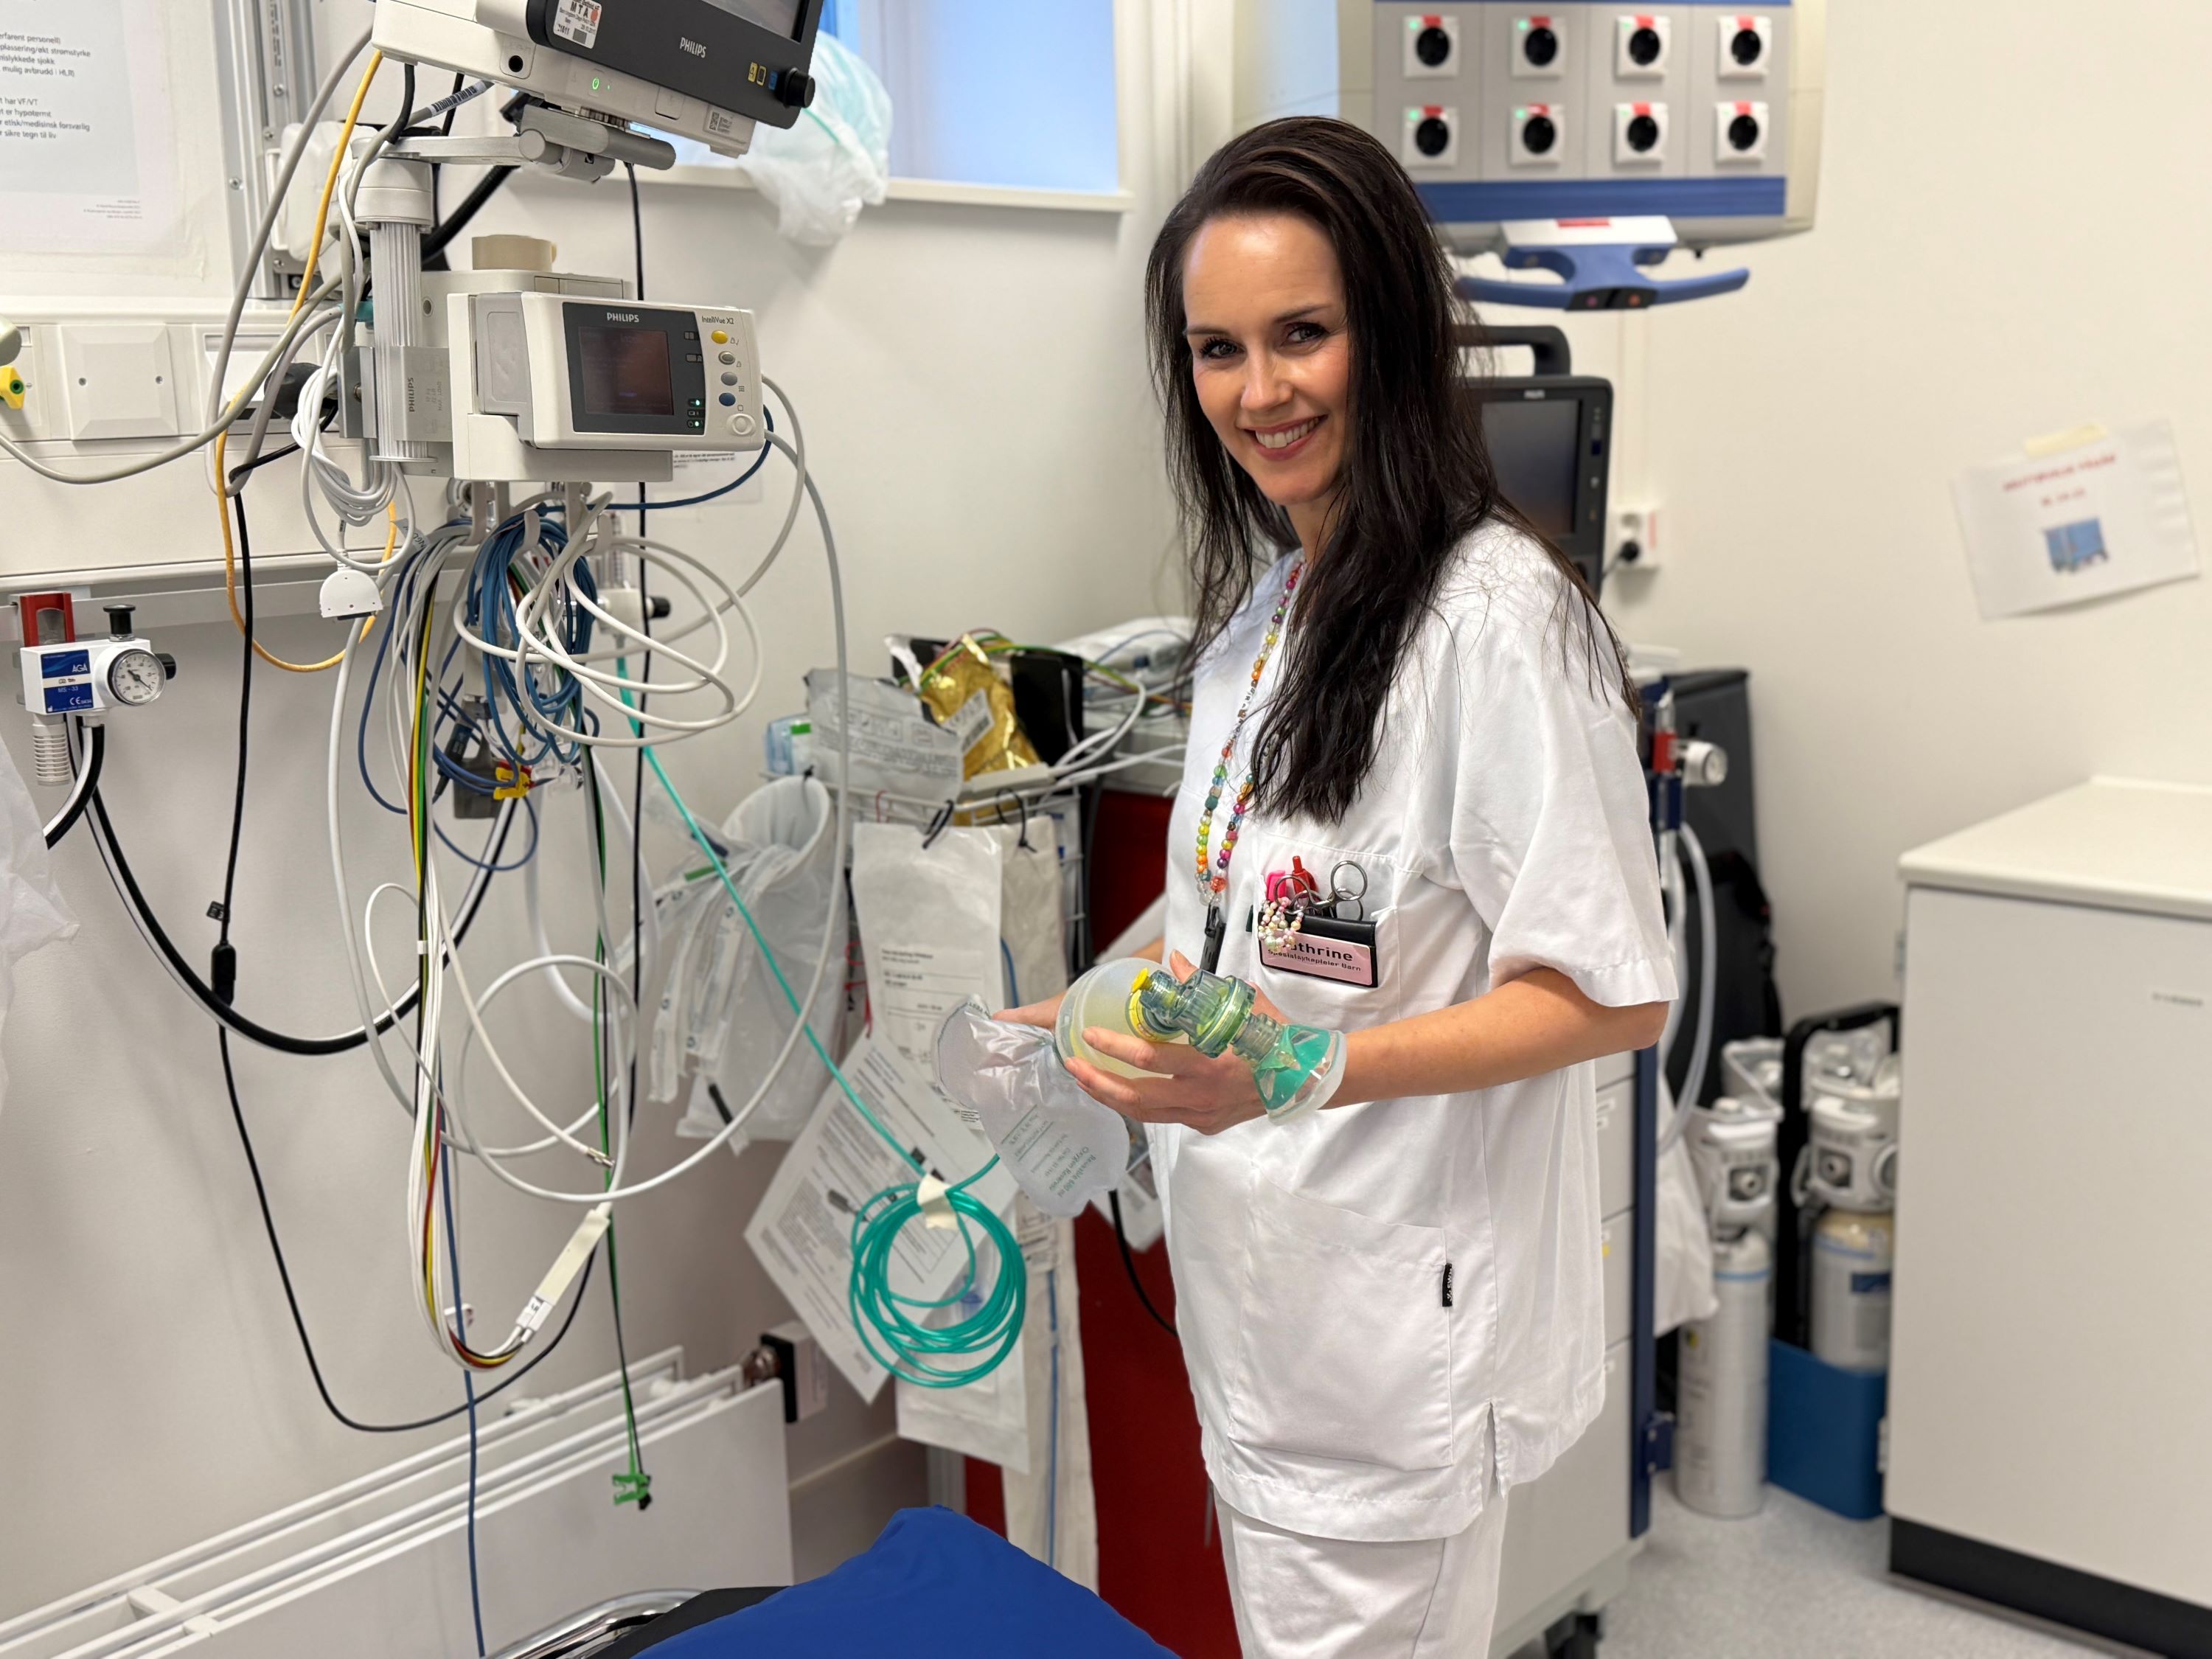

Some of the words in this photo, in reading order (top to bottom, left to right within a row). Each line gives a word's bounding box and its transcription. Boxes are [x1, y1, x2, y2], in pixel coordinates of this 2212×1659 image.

[680, 37, 706, 58] PHILIPS
[2, 66, 22, 74] mulig
[24, 67, 53, 75] avbrudd
[59, 122, 90, 131] forsvarlig
[22, 131, 38, 139] tegn
[606, 312, 640, 323] PHILIPS
[701, 316, 726, 324] IntelliVue
[726, 317, 734, 325] X2
[72, 664, 88, 672] AGA
[1341, 962, 1361, 971] Barn
[1068, 1146, 1089, 1169] Oxygen
